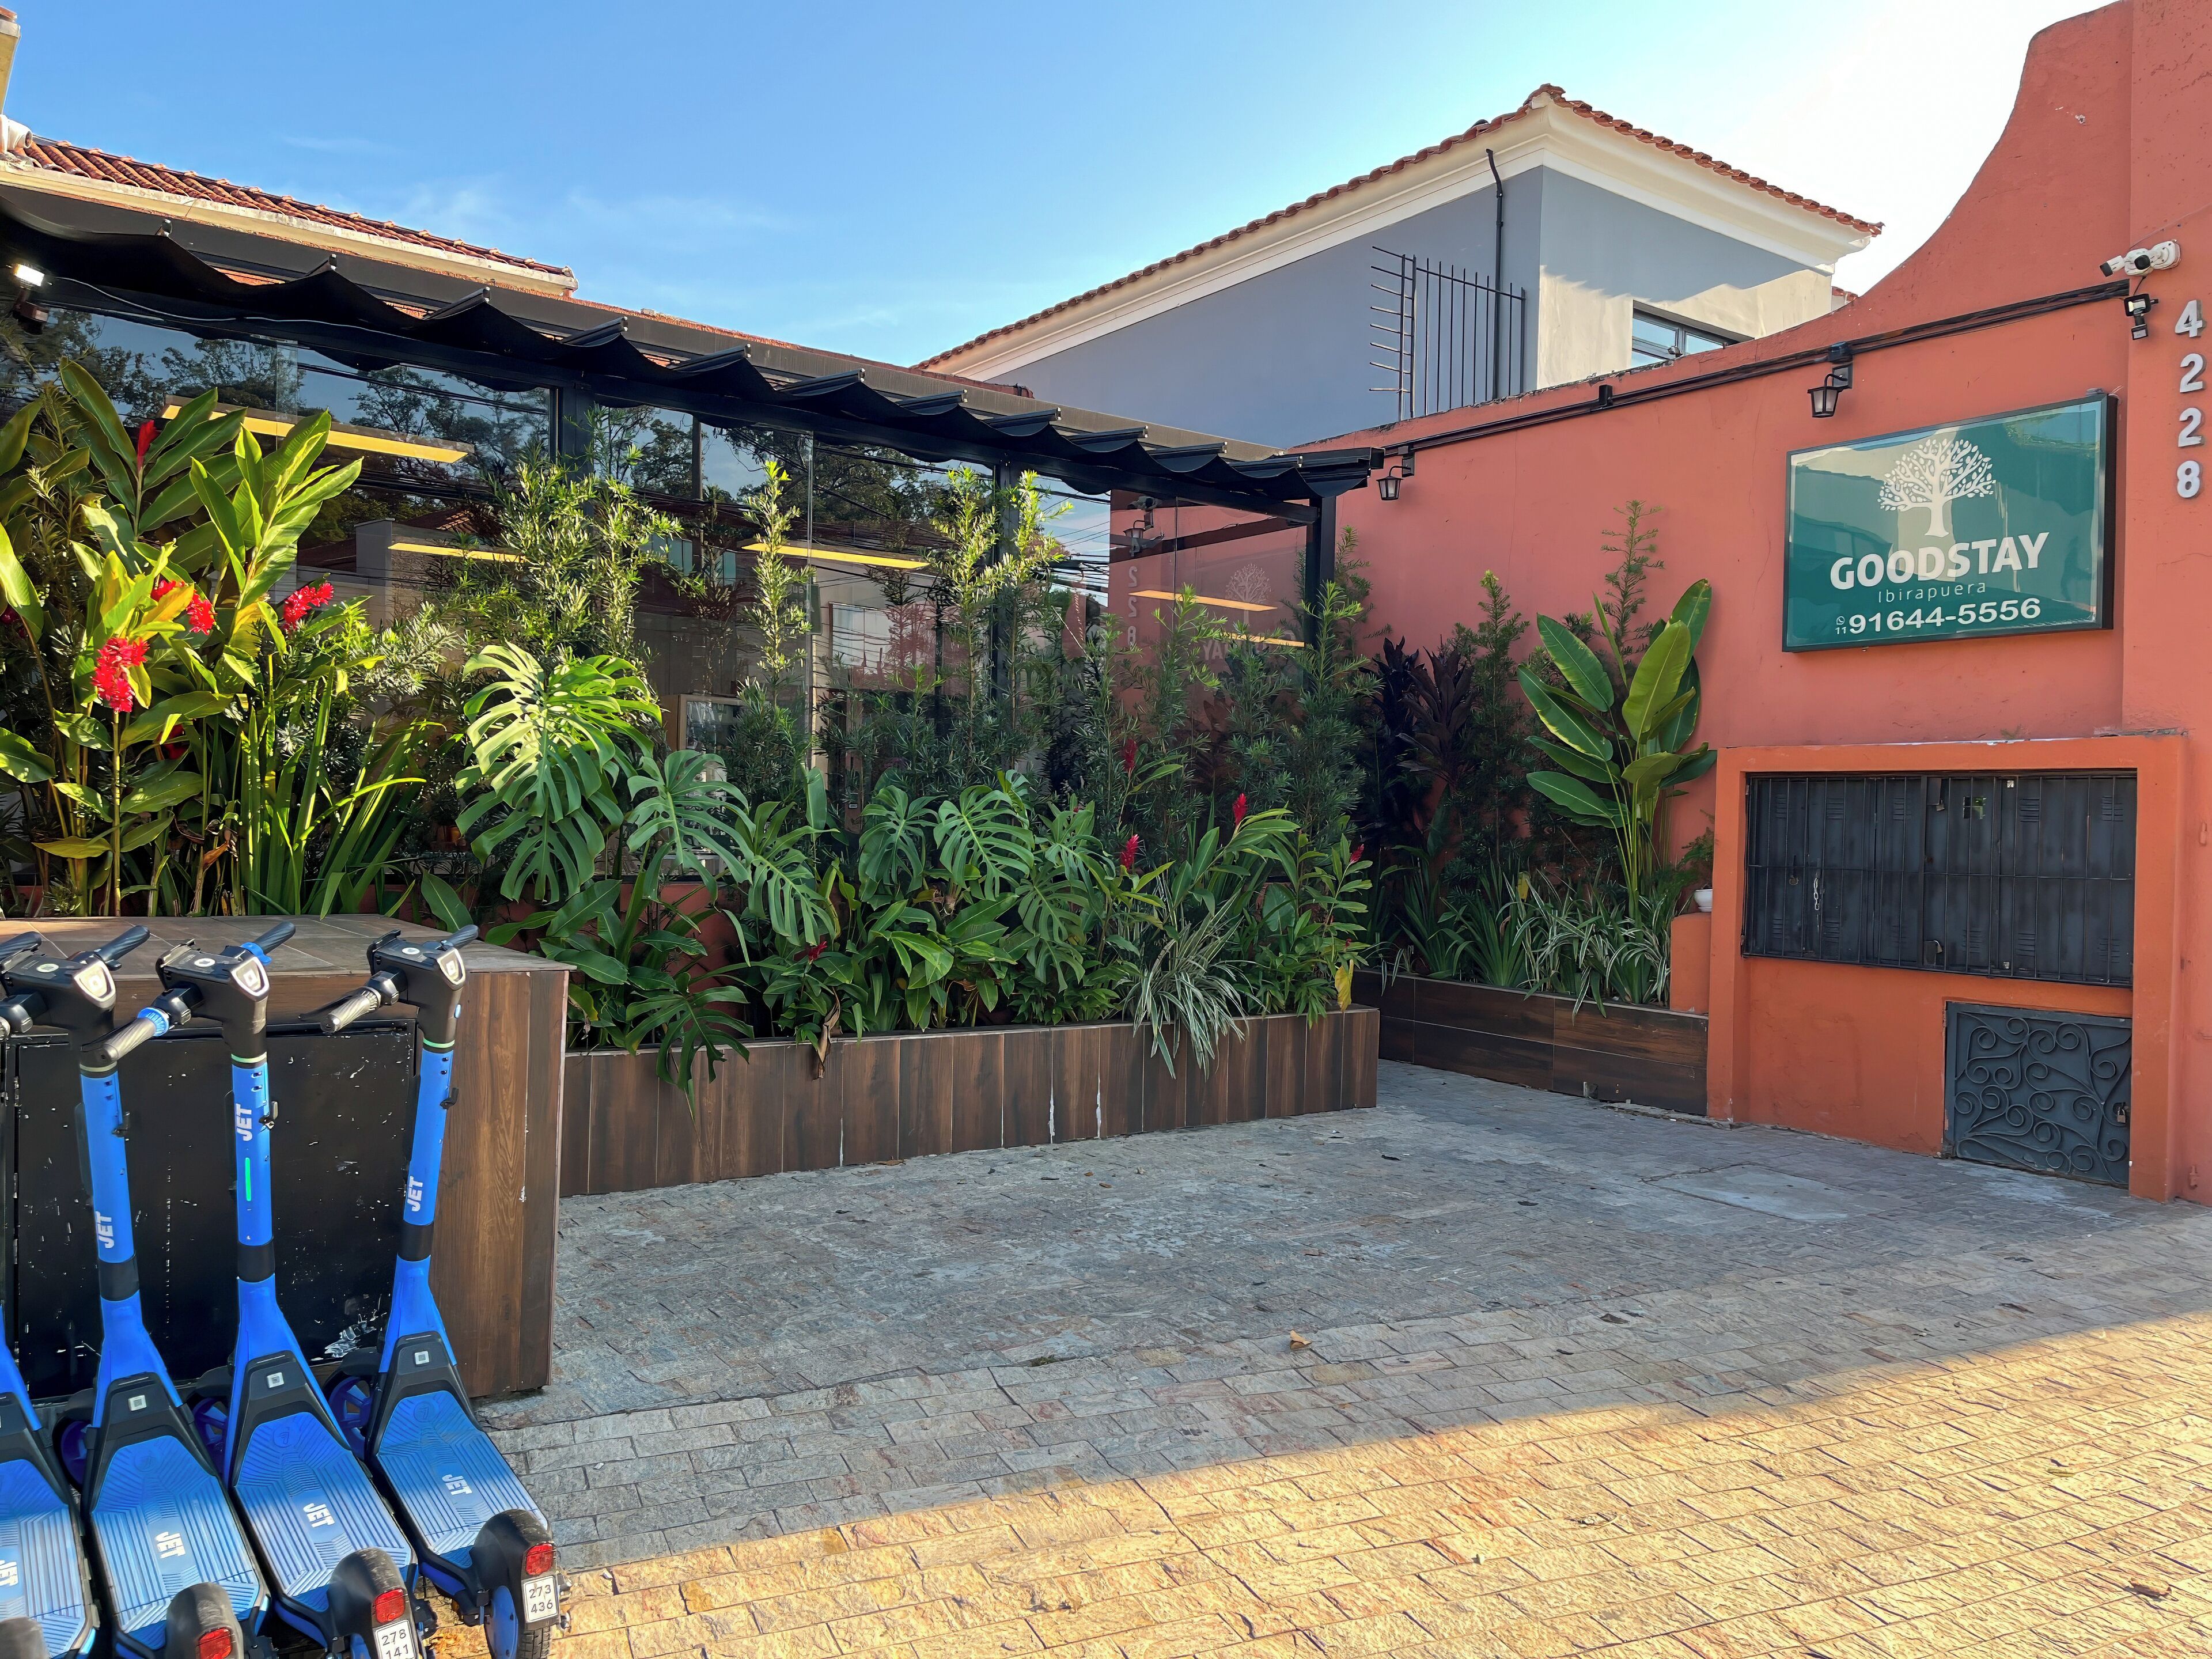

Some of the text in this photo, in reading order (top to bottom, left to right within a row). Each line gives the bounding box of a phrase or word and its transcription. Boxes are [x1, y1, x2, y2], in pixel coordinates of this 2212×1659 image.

[2175, 299, 2206, 499] 4228
[1830, 532, 2050, 590] GOODSTAY
[1878, 582, 1986, 603] Ibirapuera
[1835, 597, 2041, 635] 11 91644-5556
[236, 1103, 253, 1141] JET
[407, 1175, 423, 1212] JET
[95, 1211, 115, 1249] JET
[442, 1474, 472, 1495] JET
[303, 1502, 335, 1528] JET
[154, 1531, 186, 1559] JET
[529, 1585, 551, 1599] 273
[531, 1599, 553, 1613] 436
[381, 1629, 407, 1646] 278
[386, 1644, 408, 1659] 141
